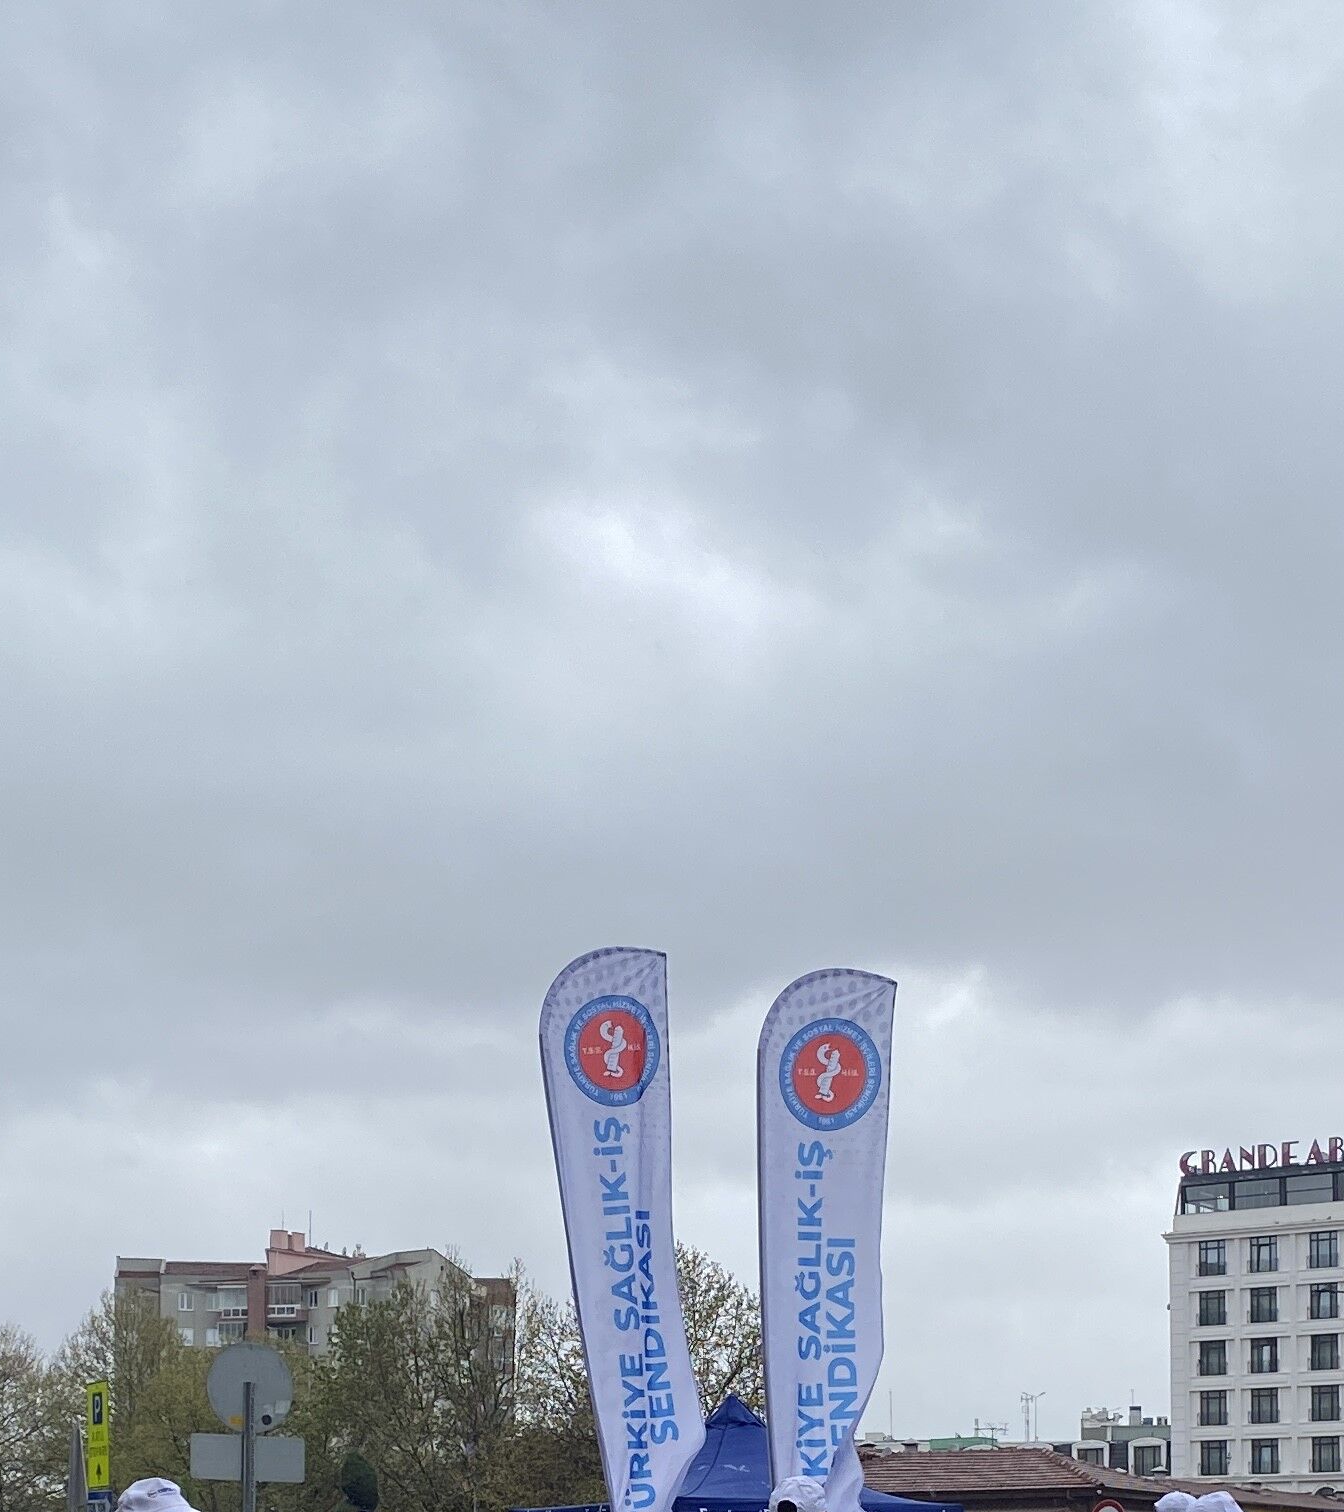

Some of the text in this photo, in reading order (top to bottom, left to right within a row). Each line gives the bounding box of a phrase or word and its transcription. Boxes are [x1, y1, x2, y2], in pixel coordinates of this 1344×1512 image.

[592, 1116, 643, 1331] SAĞLIK-İŞ
[1179, 1140, 1300, 1177] GRANDE
[634, 1209, 680, 1446] SENDİKASI
[794, 1140, 834, 1477] KİYE SAĞLIK-İŞ
[822, 1236, 857, 1452] ENDİKASI
